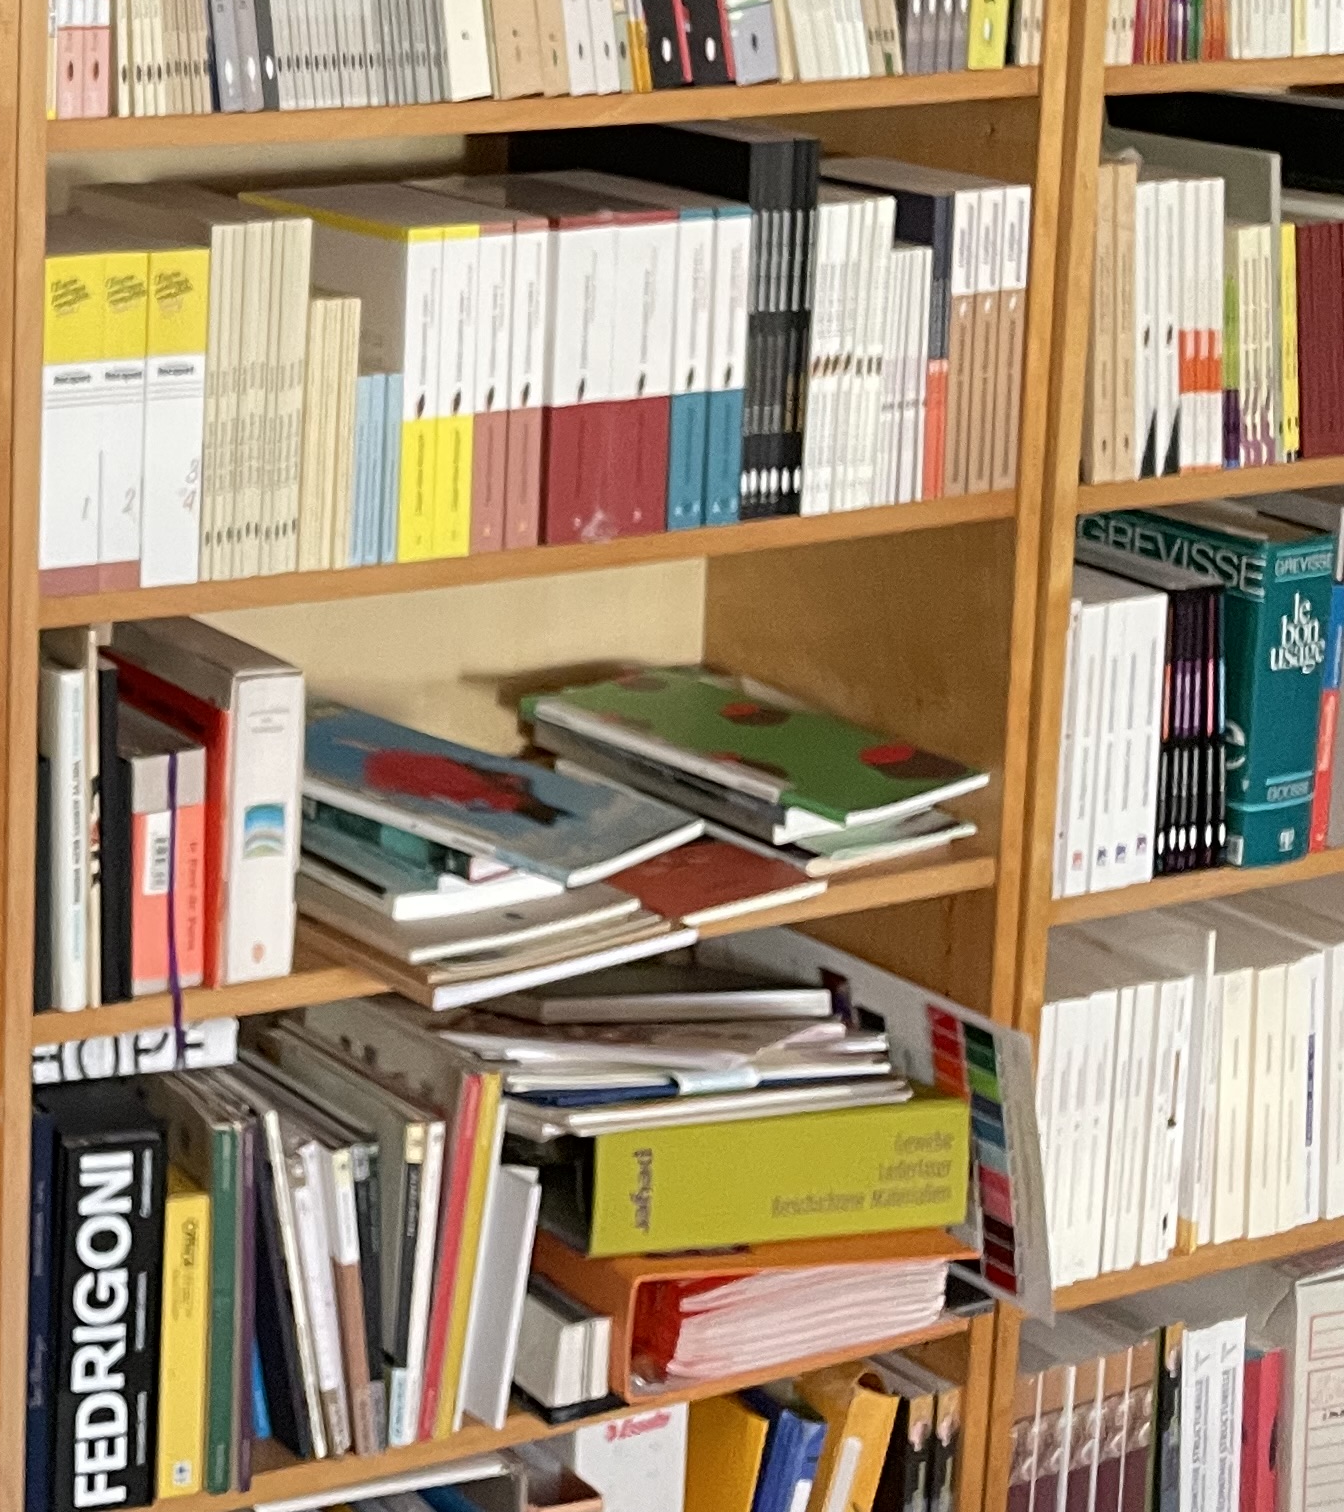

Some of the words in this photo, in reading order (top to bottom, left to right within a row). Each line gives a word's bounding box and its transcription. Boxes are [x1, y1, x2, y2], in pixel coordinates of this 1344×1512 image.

[1076, 513, 1267, 599] GREVISSE
[1274, 552, 1333, 578] GREVISSE
[1293, 591, 1311, 617] le
[1280, 615, 1320, 648] bon
[1269, 639, 1326, 675] usage
[70, 1150, 134, 1508] FEDRIGONI
